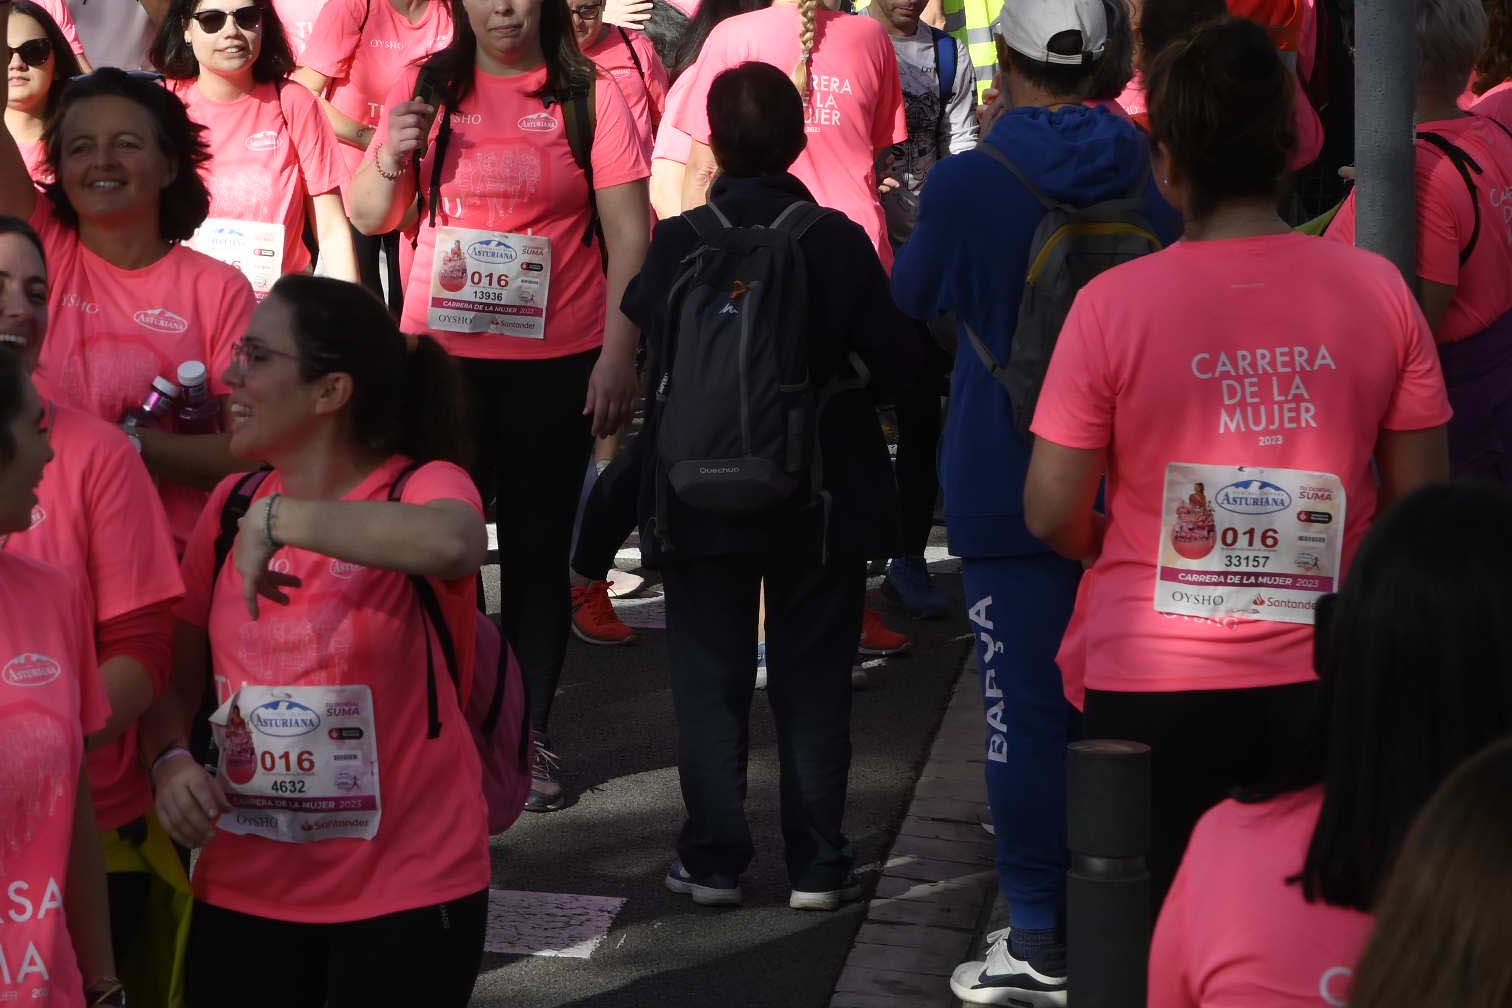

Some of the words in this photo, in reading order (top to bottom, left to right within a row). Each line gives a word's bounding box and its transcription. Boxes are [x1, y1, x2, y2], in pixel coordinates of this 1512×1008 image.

[816, 92, 838, 109] LA
[521, 118, 557, 130] ASTURIANA
[472, 247, 514, 260] ASTURIANA
[470, 271, 510, 288] 016
[473, 290, 503, 302] 13936
[443, 300, 473, 310] CARRERA
[138, 314, 184, 331] ASTURIANA
[438, 314, 473, 326] OYSHO
[500, 319, 536, 330] Santander
[1191, 344, 1337, 380] CARRERA
[1222, 378, 1261, 405] DE
[1274, 374, 1311, 402] LA
[1218, 402, 1319, 434] MUJER
[1258, 434, 1284, 446] 2023
[1221, 491, 1286, 508] ASTURIANA
[1298, 491, 1333, 502] SUMA
[1220, 527, 1280, 549] 016
[1224, 555, 1270, 569] 33157
[1178, 572, 1226, 583] CARRERA
[1227, 575, 1241, 584] DE
[1242, 576, 1257, 584] LA
[1257, 577, 1294, 586] MUJER
[1295, 578, 1320, 588] 2023
[1171, 590, 1225, 607] OYSHO
[7, 665, 56, 682] ASTURIANA
[255, 713, 316, 728] ASTURIANA
[326, 706, 361, 718] SUMA
[260, 750, 316, 773] 016
[271, 780, 306, 794] 4632
[301, 800, 337, 810] MUJER
[339, 799, 363, 809] 2023
[236, 813, 279, 829] OYSHO
[312, 817, 369, 831] Santander
